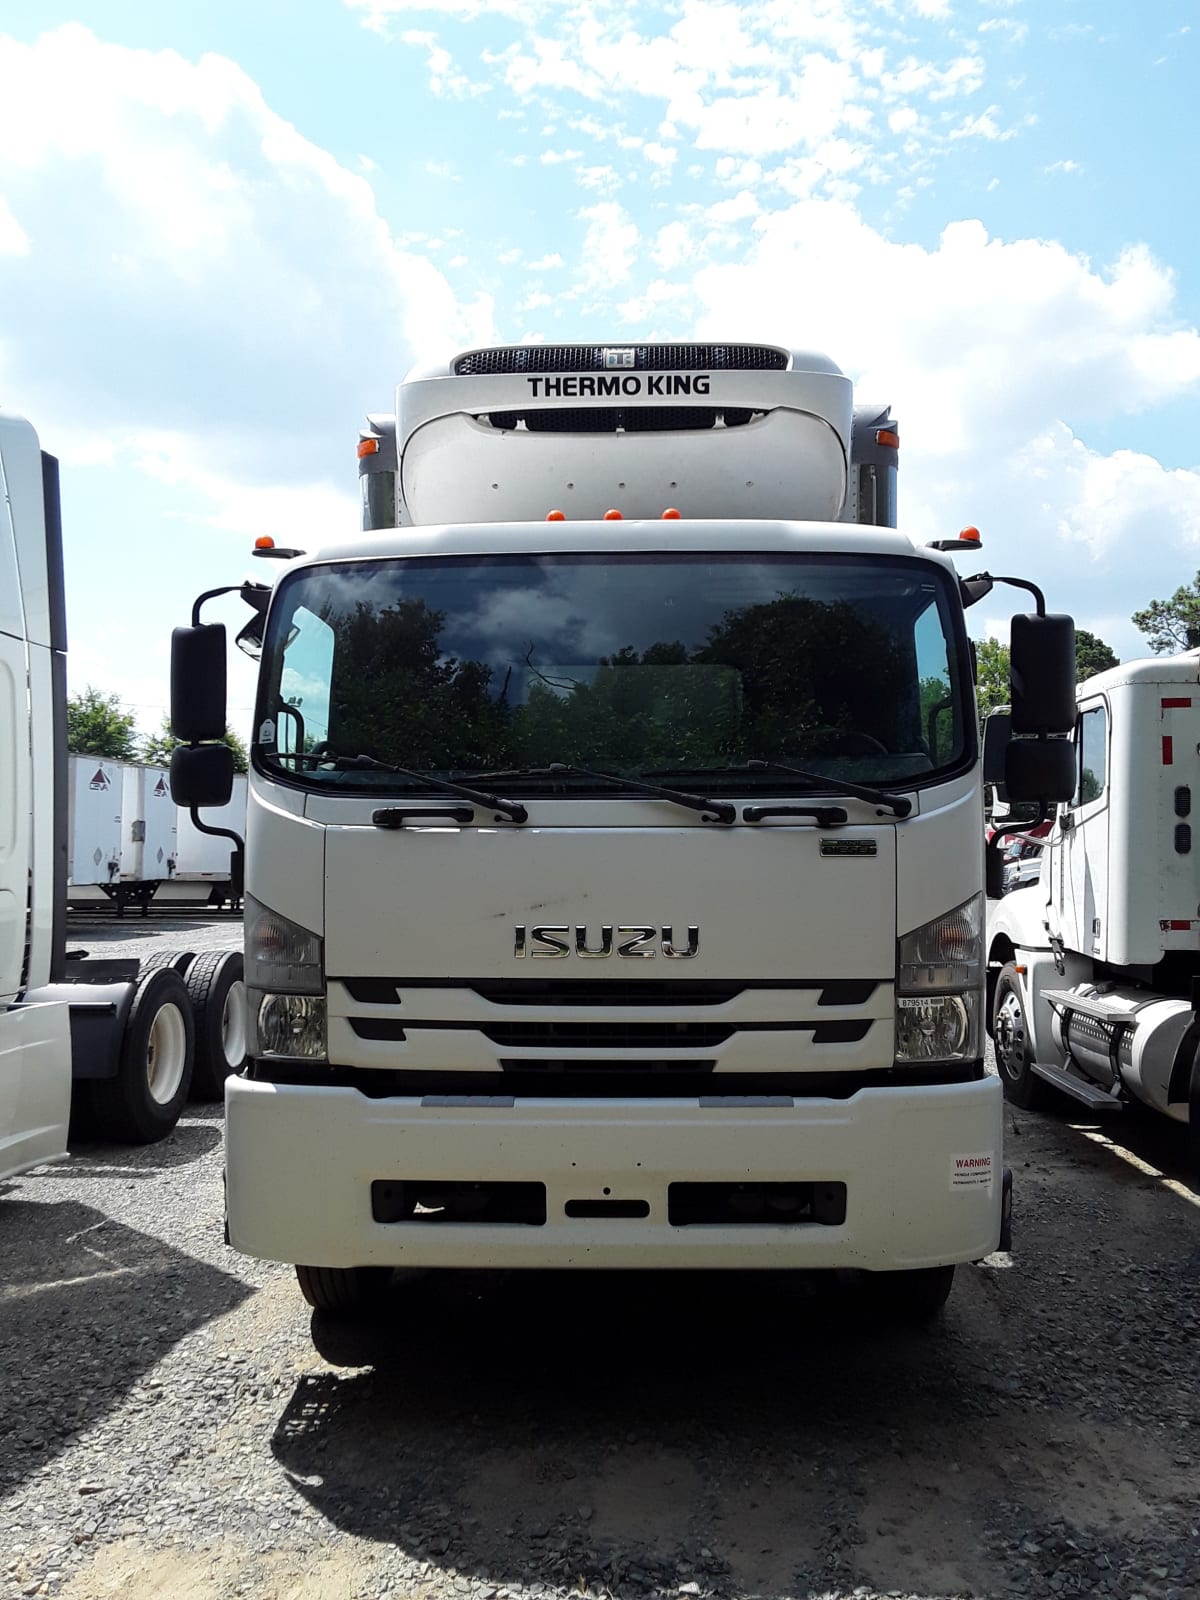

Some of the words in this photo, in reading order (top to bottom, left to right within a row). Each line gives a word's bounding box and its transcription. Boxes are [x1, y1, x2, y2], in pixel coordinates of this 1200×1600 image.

[527, 376, 642, 397] THERMO
[647, 375, 711, 395] KING
[514, 925, 699, 959] ISUZU
[955, 1157, 991, 1169] WARNING
